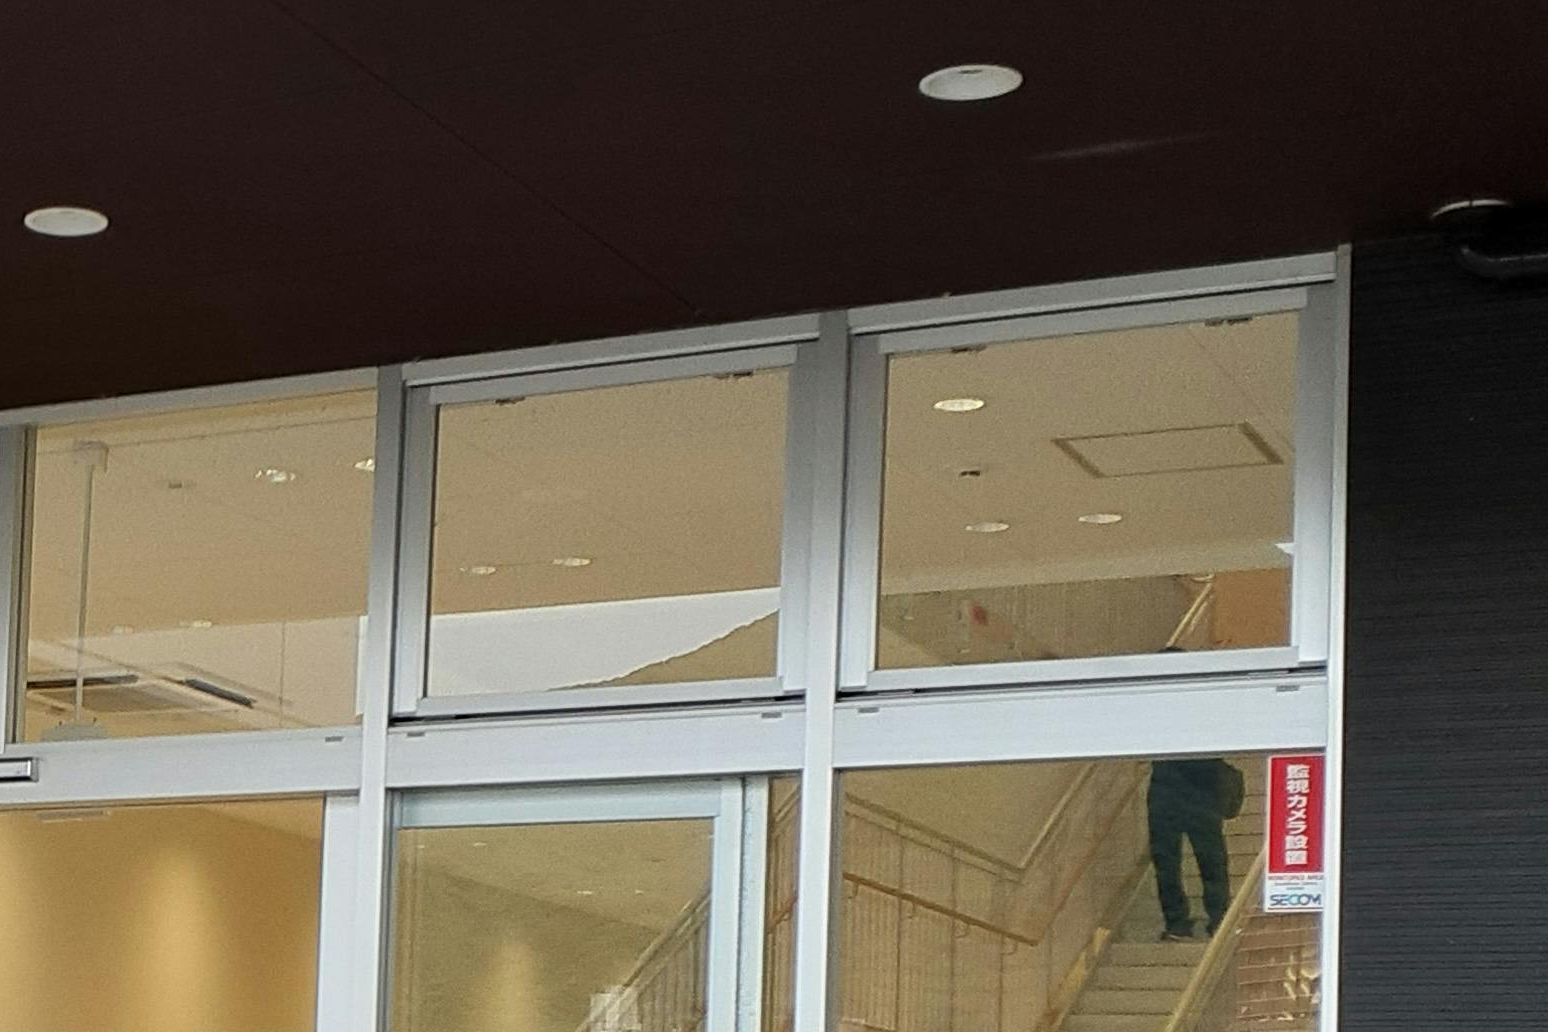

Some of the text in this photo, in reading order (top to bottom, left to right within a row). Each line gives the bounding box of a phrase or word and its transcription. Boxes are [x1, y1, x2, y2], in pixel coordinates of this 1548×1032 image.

[1285, 764, 1310, 865] 監視カメラ設置
[1269, 893, 1322, 907] SECOM
